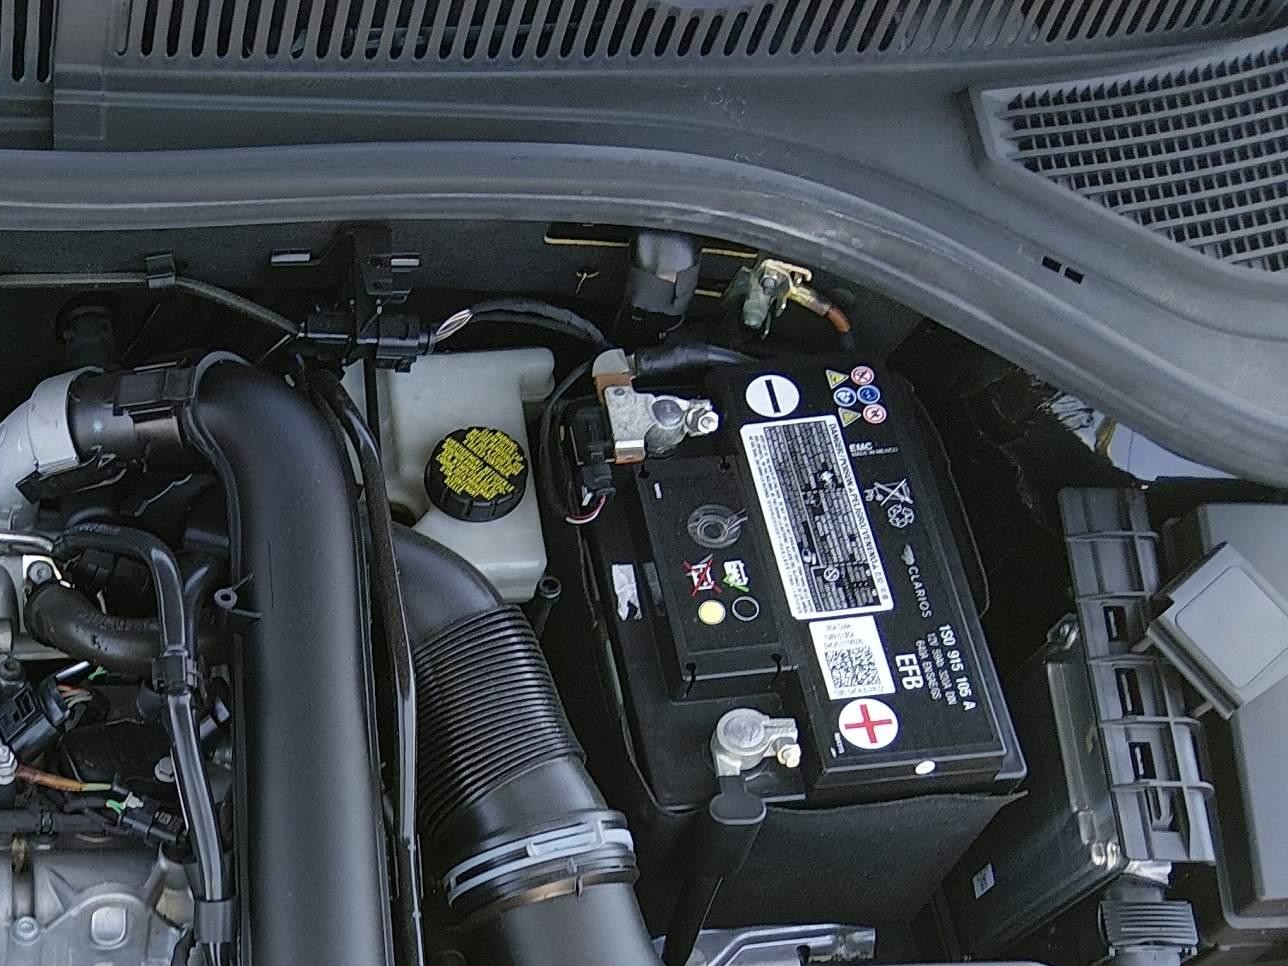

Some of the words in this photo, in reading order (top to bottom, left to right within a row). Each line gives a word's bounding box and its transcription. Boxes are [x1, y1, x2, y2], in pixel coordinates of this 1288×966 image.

[848, 441, 873, 453] EMC
[908, 566, 932, 618] CLARIOS
[938, 623, 956, 647] 1S0
[895, 652, 925, 691] EFB
[946, 649, 965, 672] 915
[955, 676, 974, 698] 105
[962, 701, 977, 711] A
